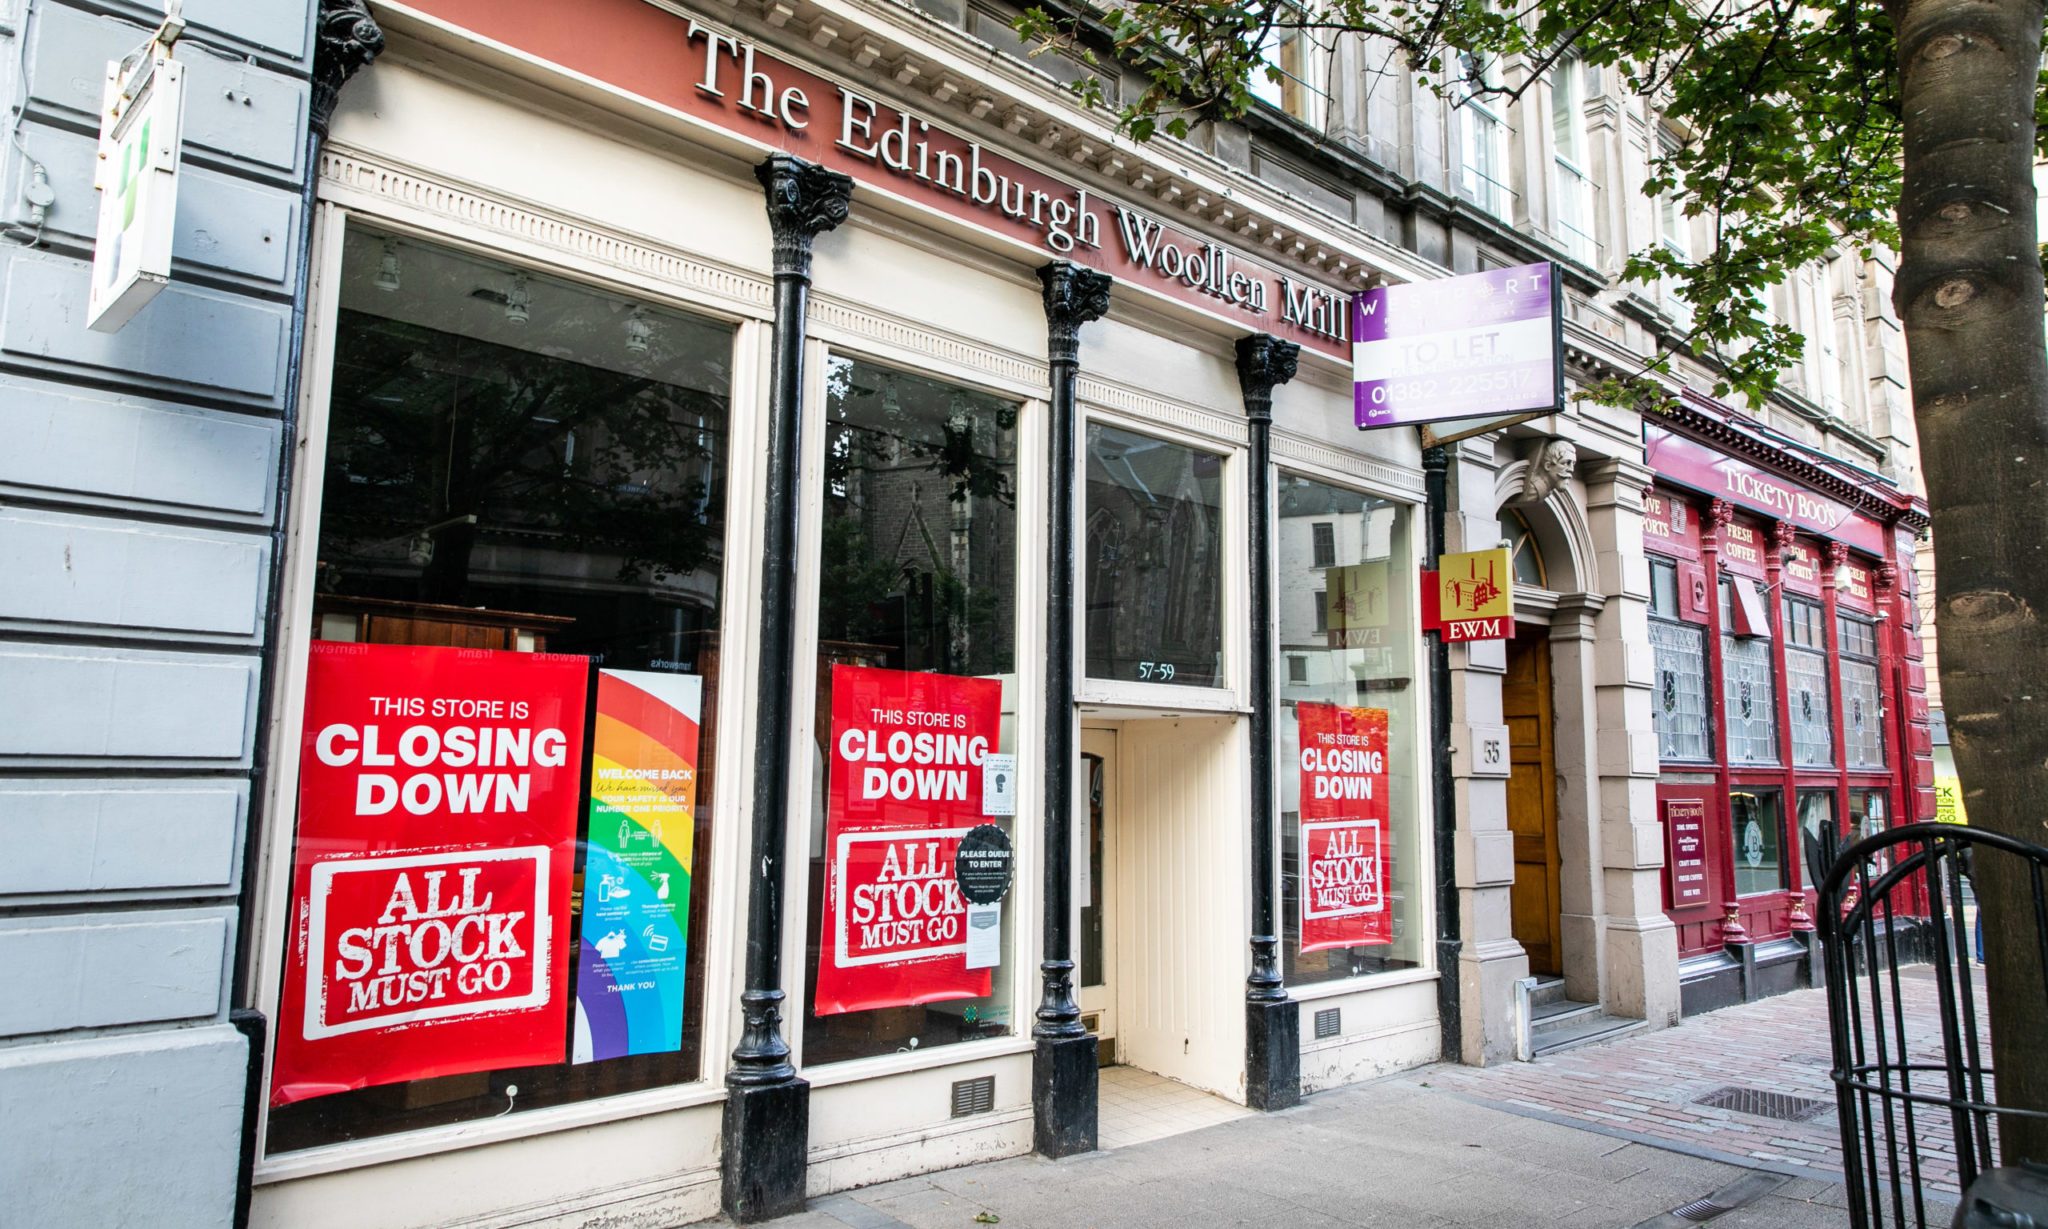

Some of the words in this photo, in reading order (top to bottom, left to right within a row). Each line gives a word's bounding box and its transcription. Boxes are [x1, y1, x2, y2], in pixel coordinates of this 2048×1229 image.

[687, 19, 809, 129] The
[835, 86, 1102, 252] Edinburgh
[1115, 205, 1268, 313] Woollen
[1282, 276, 1348, 342] Mill
[1401, 342, 1439, 364] TO
[1453, 332, 1500, 360] LET
[1371, 379, 1438, 404] 01382
[1641, 516, 1669, 537] PORTS
[1727, 523, 1753, 543] FRESH
[1726, 542, 1756, 562] COFFEE
[1788, 562, 1813, 580] SPIRITS
[1849, 566, 1866, 582] GREAT
[1449, 618, 1500, 640] EWM
[1139, 661, 1175, 681] 57-59
[370, 696, 425, 717] THIS
[431, 699, 503, 720] STORE
[510, 702, 529, 720] IS
[871, 708, 903, 725] THIS
[906, 711, 950, 728] STORE
[953, 714, 966, 729] IS
[315, 723, 567, 768] CLOSING
[838, 728, 989, 767] CLOSING
[1317, 733, 1335, 744] THIS
[1336, 734, 1360, 746] STORE
[1361, 735, 1369, 746] IS
[1484, 740, 1500, 763] 55
[1301, 748, 1382, 774] CLOSING
[598, 768, 659, 780] WELCOME
[661, 769, 692, 780] BACK
[862, 768, 968, 801] DOWN
[355, 773, 531, 816] DOWN
[595, 782, 613, 792] We
[616, 781, 637, 792] have
[1315, 776, 1372, 800] DOWN
[596, 805, 631, 813] NUMBER
[652, 805, 689, 813] PRIORITY
[601, 795, 625, 803] YOUR
[627, 795, 658, 803] SAFETY
[668, 795, 686, 803] OUR
[960, 850, 987, 858] PLEASE
[988, 850, 1009, 858] QUEUE
[1325, 830, 1363, 859] ALL
[876, 842, 946, 882] ALL
[1312, 856, 1375, 889] STOCK
[377, 867, 493, 925] ALL
[852, 879, 967, 924] STOCK
[1317, 886, 1350, 907] MUST
[1353, 884, 1371, 902] GO
[860, 921, 924, 950] MUST
[927, 916, 958, 941] GO
[336, 911, 526, 982] STOCK
[346, 970, 452, 1014] MUST
[459, 960, 511, 993] GO
[607, 982, 636, 993] THANK
[637, 981, 656, 989] YOU
